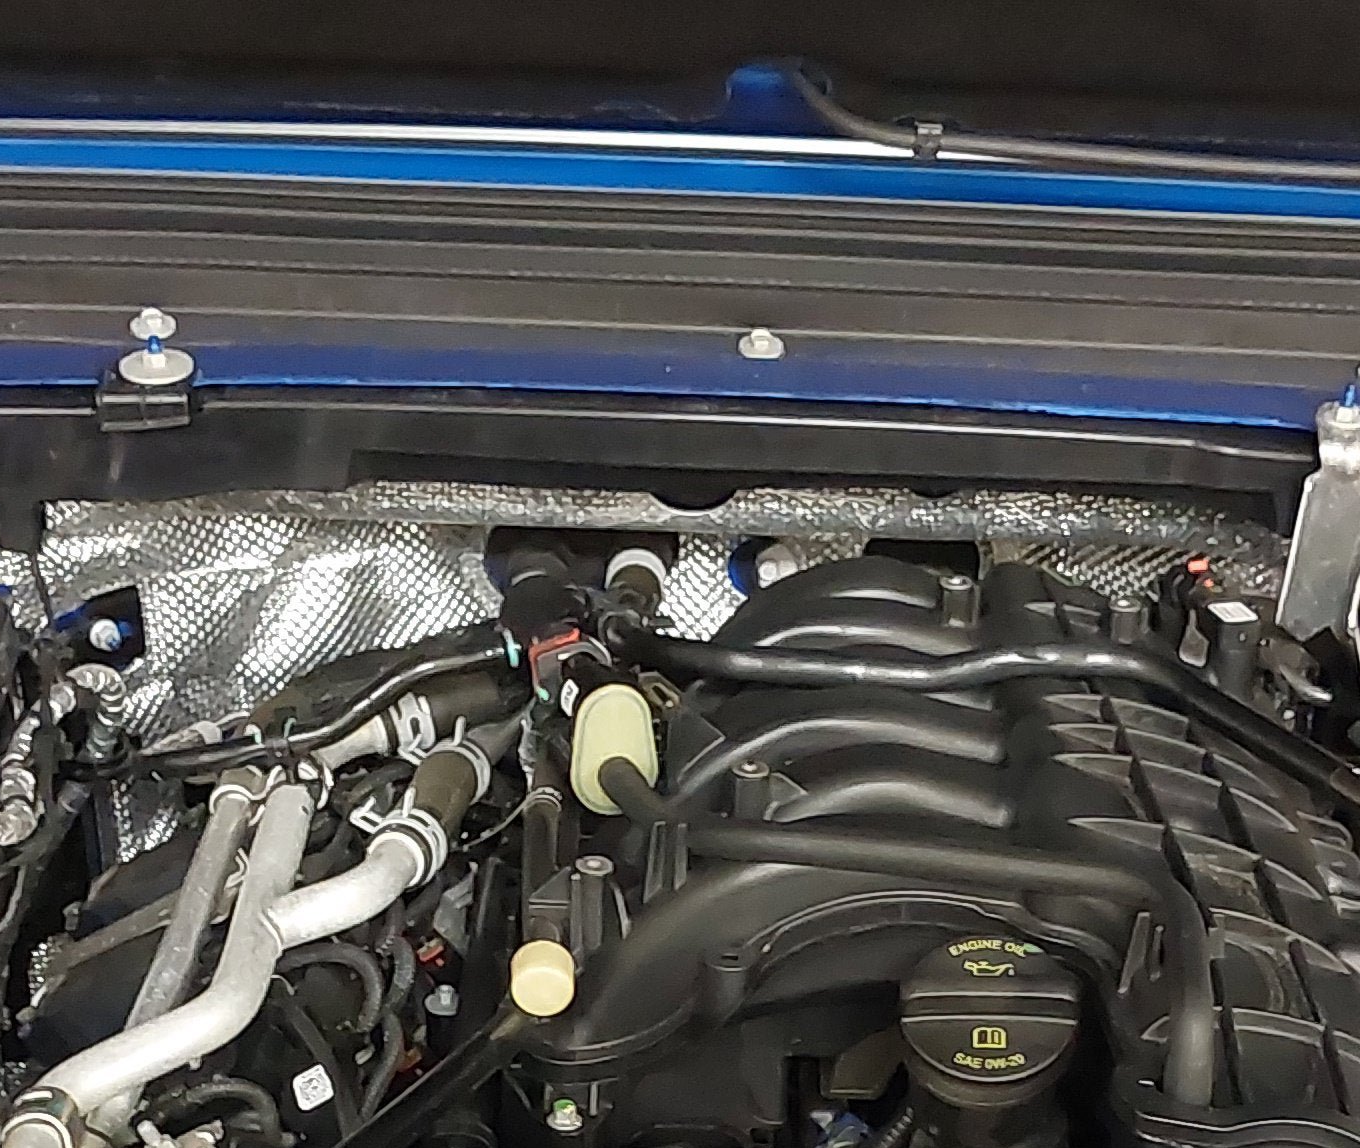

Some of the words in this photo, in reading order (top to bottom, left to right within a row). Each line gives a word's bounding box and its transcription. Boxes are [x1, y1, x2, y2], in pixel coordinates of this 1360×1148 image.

[948, 939, 1002, 957] ENGINE
[1004, 942, 1026, 958] OIL
[953, 1052, 983, 1069] SAE
[984, 1053, 1025, 1069] 0W-20
